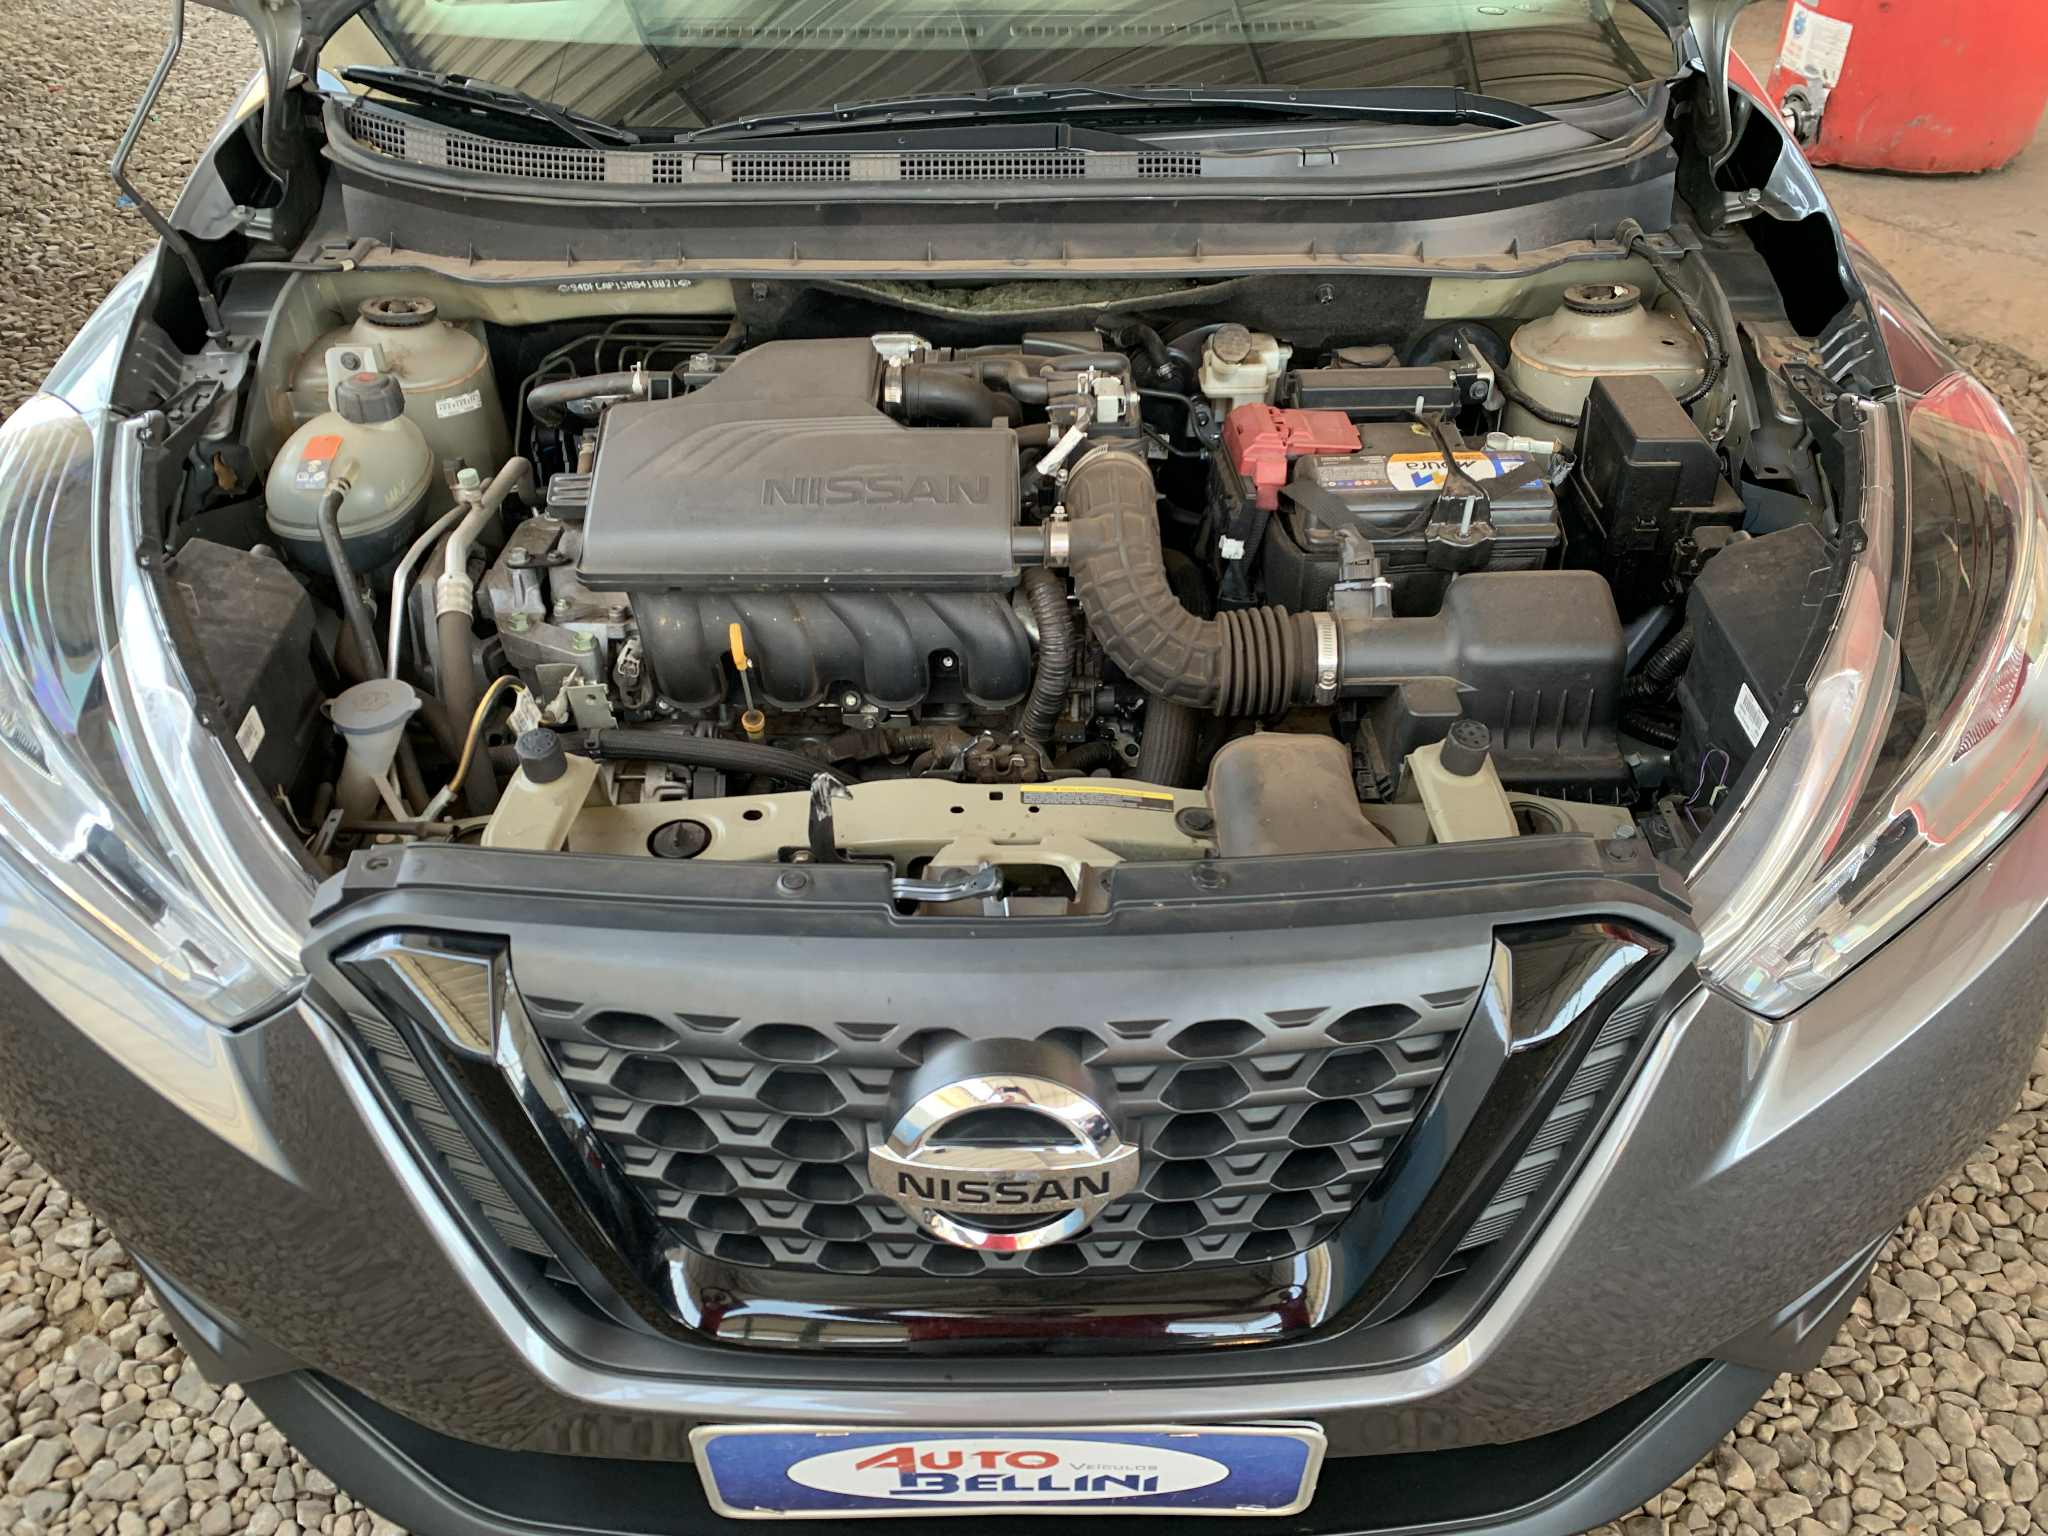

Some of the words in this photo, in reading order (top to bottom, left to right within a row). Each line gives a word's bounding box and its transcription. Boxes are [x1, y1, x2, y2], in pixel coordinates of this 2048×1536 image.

[761, 474, 991, 505] NISSAN
[897, 1171, 1110, 1204] NISSAN
[855, 1446, 1060, 1473] AUTO
[889, 1472, 1159, 1495] BELLINI
